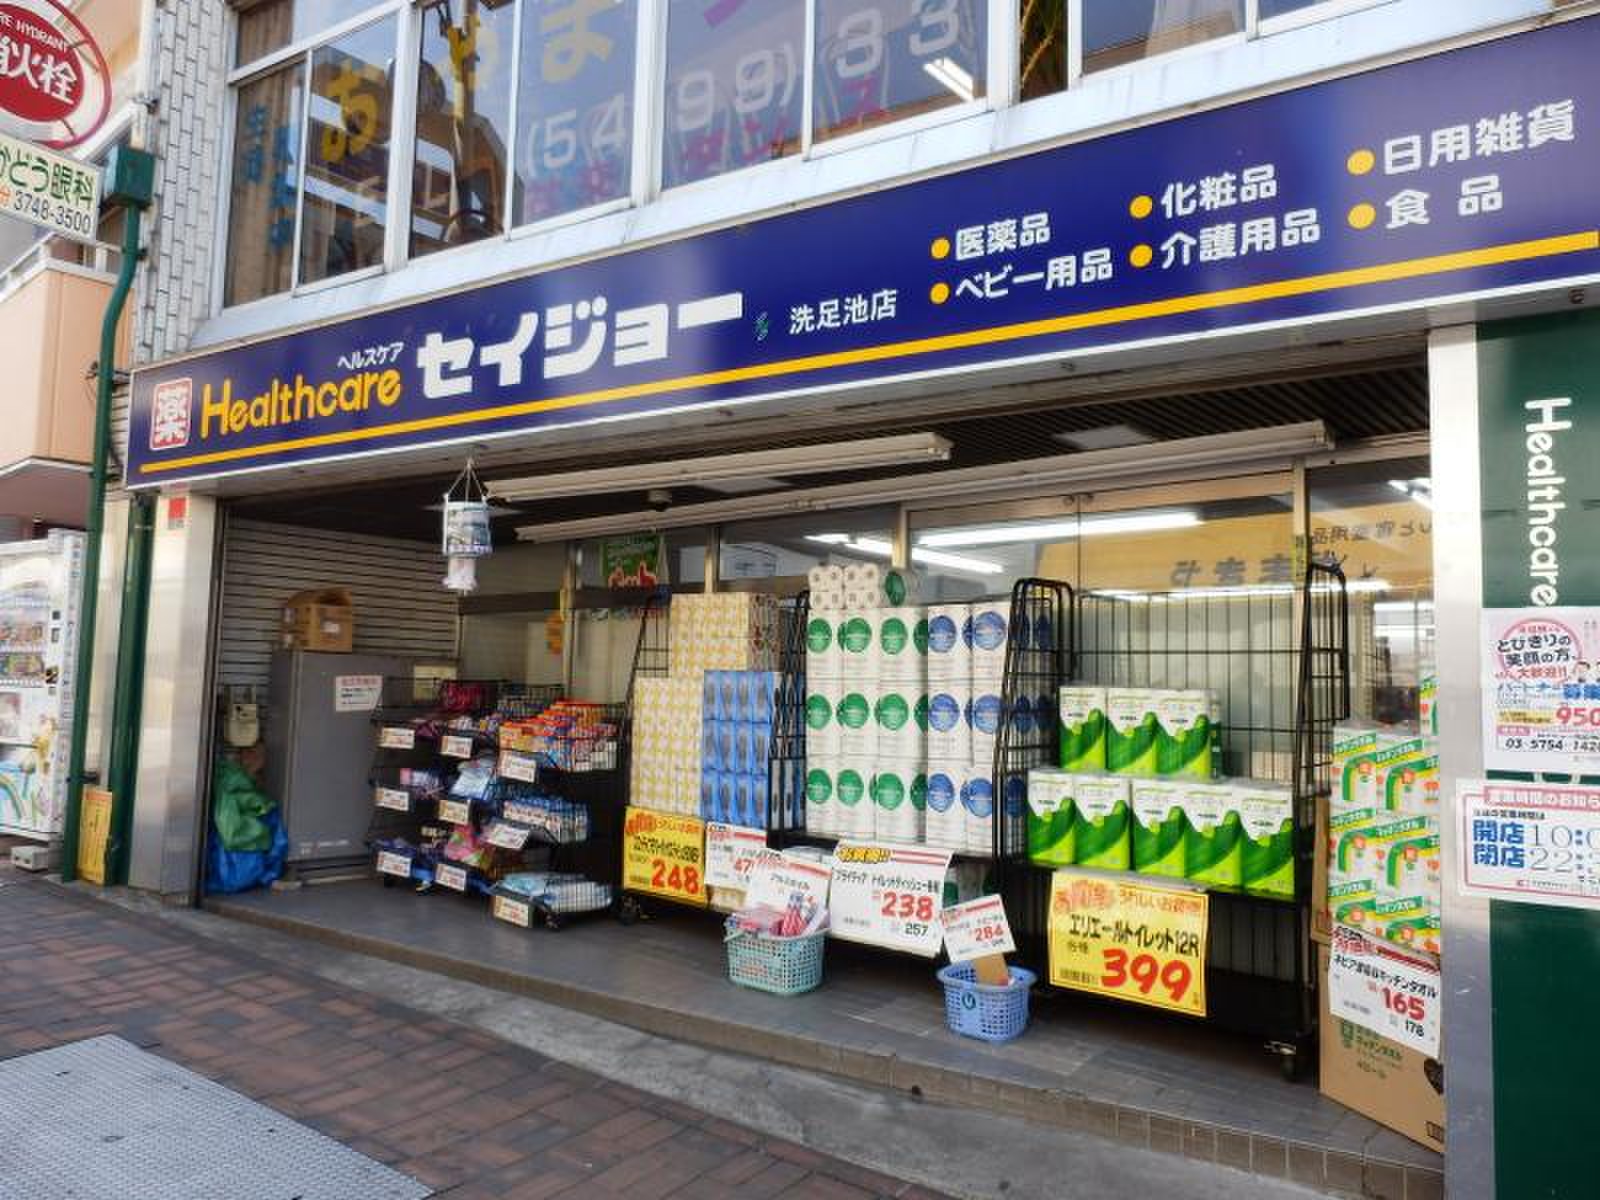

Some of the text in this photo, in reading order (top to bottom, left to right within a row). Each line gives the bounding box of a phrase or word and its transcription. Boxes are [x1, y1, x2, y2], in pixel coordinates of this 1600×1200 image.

[16, 20, 68, 53] HYDRANT
[1383, 99, 1575, 175] 日用雑貨
[15, 191, 92, 235] 3748-3500
[1160, 164, 1277, 219] 化粧品
[955, 212, 1051, 260] 医薬品
[1159, 207, 1321, 269] 介護用品
[955, 247, 1113, 300] ベビー用品
[789, 288, 897, 336] 洗足池店
[337, 342, 404, 370] ヘルスケア
[417, 292, 743, 399] セイジョー
[201, 369, 401, 439] Healthcare
[1525, 397, 1573, 606] Healthcare
[1497, 634, 1572, 653] とびきりの
[1473, 820, 1524, 844] 開店
[651, 858, 699, 895] 248
[1474, 844, 1524, 868] 閉店
[881, 891, 934, 922] 238
[905, 923, 929, 936] 257
[1101, 948, 1192, 1003] 399
[1381, 986, 1425, 1021] 165
[1405, 1019, 1425, 1037] 178
